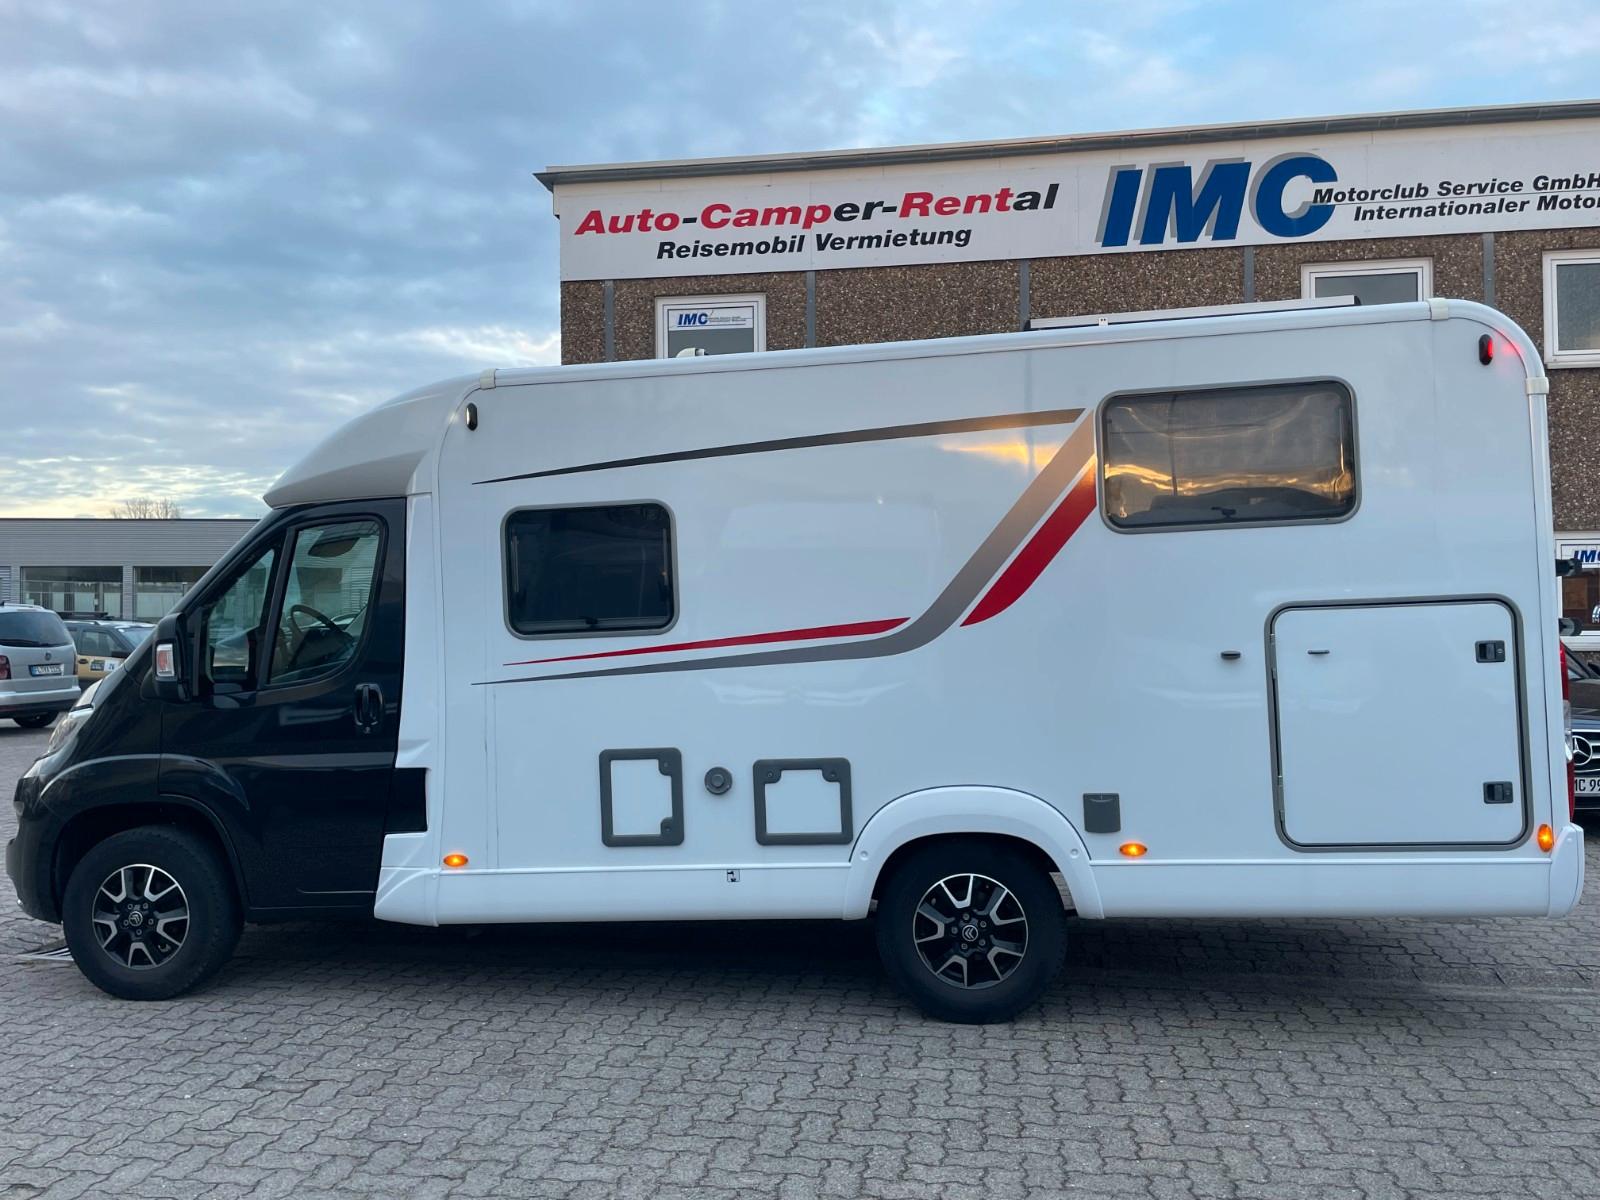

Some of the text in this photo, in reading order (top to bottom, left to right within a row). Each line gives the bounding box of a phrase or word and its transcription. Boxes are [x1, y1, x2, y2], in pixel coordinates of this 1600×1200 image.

[1097, 152, 1338, 248] IMC
[1312, 172, 1600, 204] Motorclub Service GmbH
[574, 184, 1060, 236] Auto-Camper-Rental
[1353, 197, 1530, 222] Internationaler
[656, 226, 973, 260] Reisemobil Vermietung
[677, 312, 709, 326] IMC
[1573, 550, 1600, 563] IM
